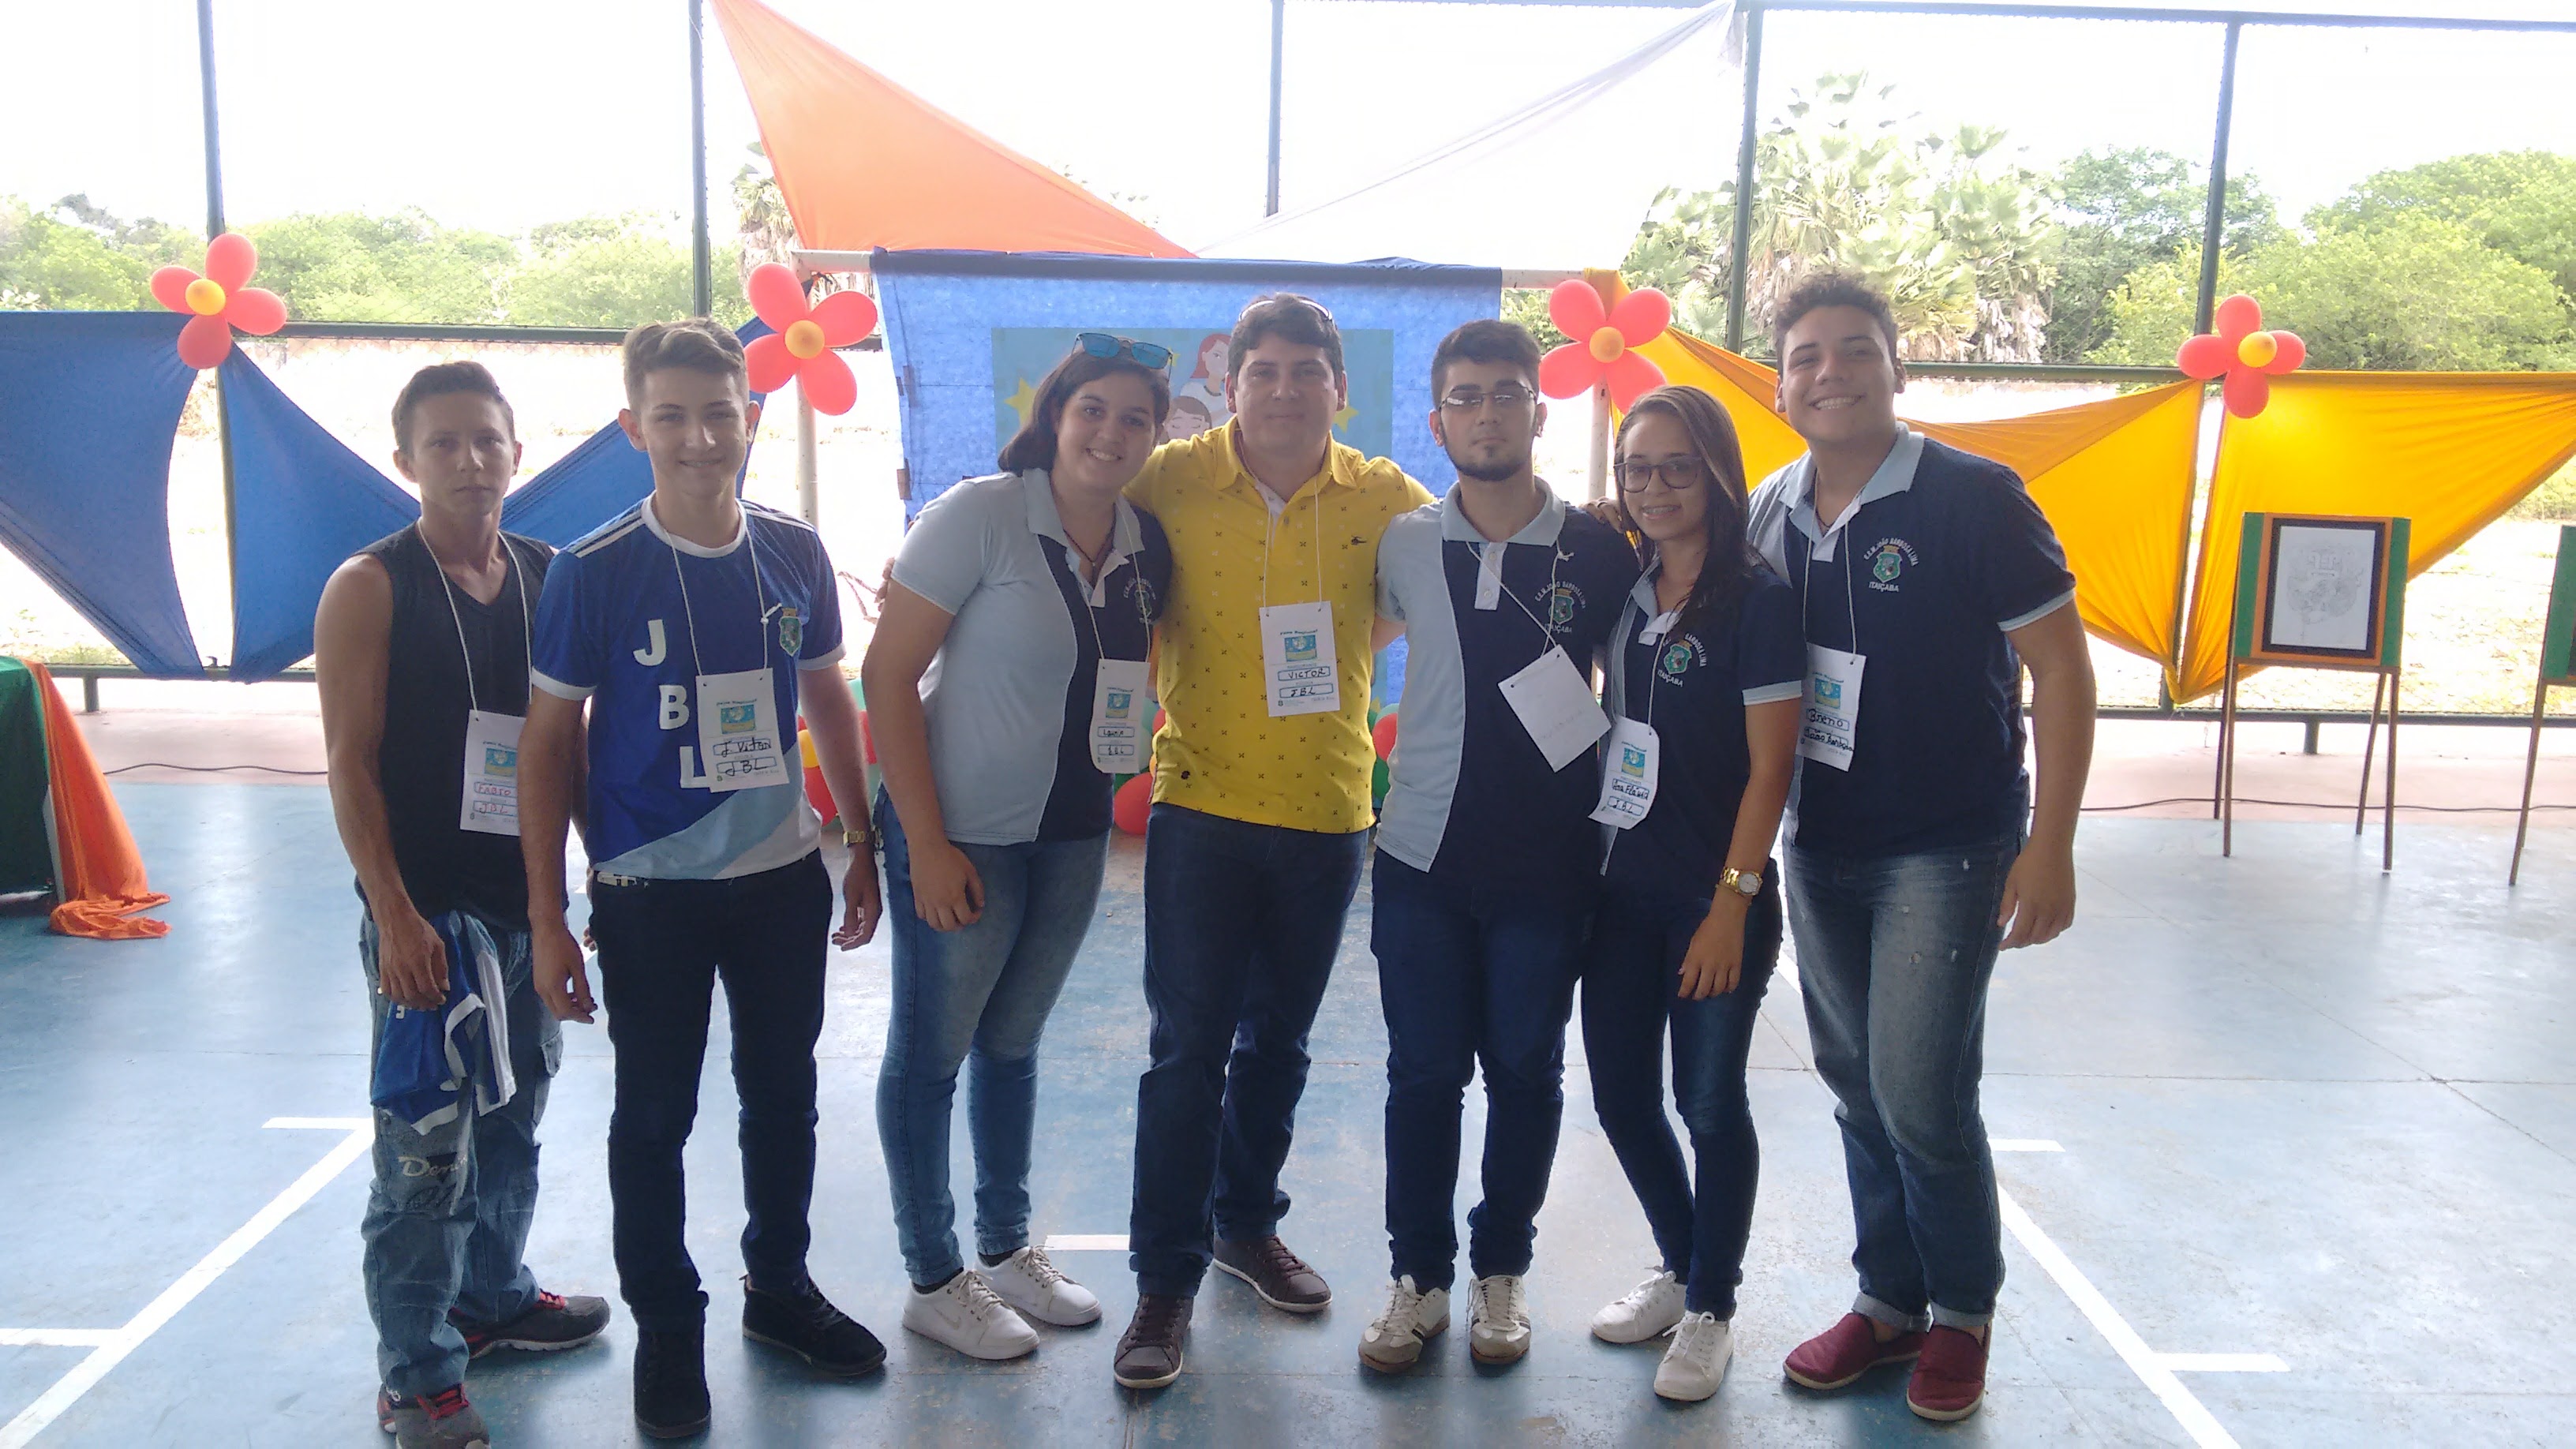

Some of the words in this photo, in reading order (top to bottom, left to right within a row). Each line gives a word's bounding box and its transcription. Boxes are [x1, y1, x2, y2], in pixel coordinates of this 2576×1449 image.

[1889, 537, 1914, 554] BARBOSA
[1908, 549, 1919, 566] LIMA
[1869, 581, 1900, 593] ITAIÇABA
[1698, 653, 1708, 668] LIMA
[1288, 668, 1326, 679] VICTOR
